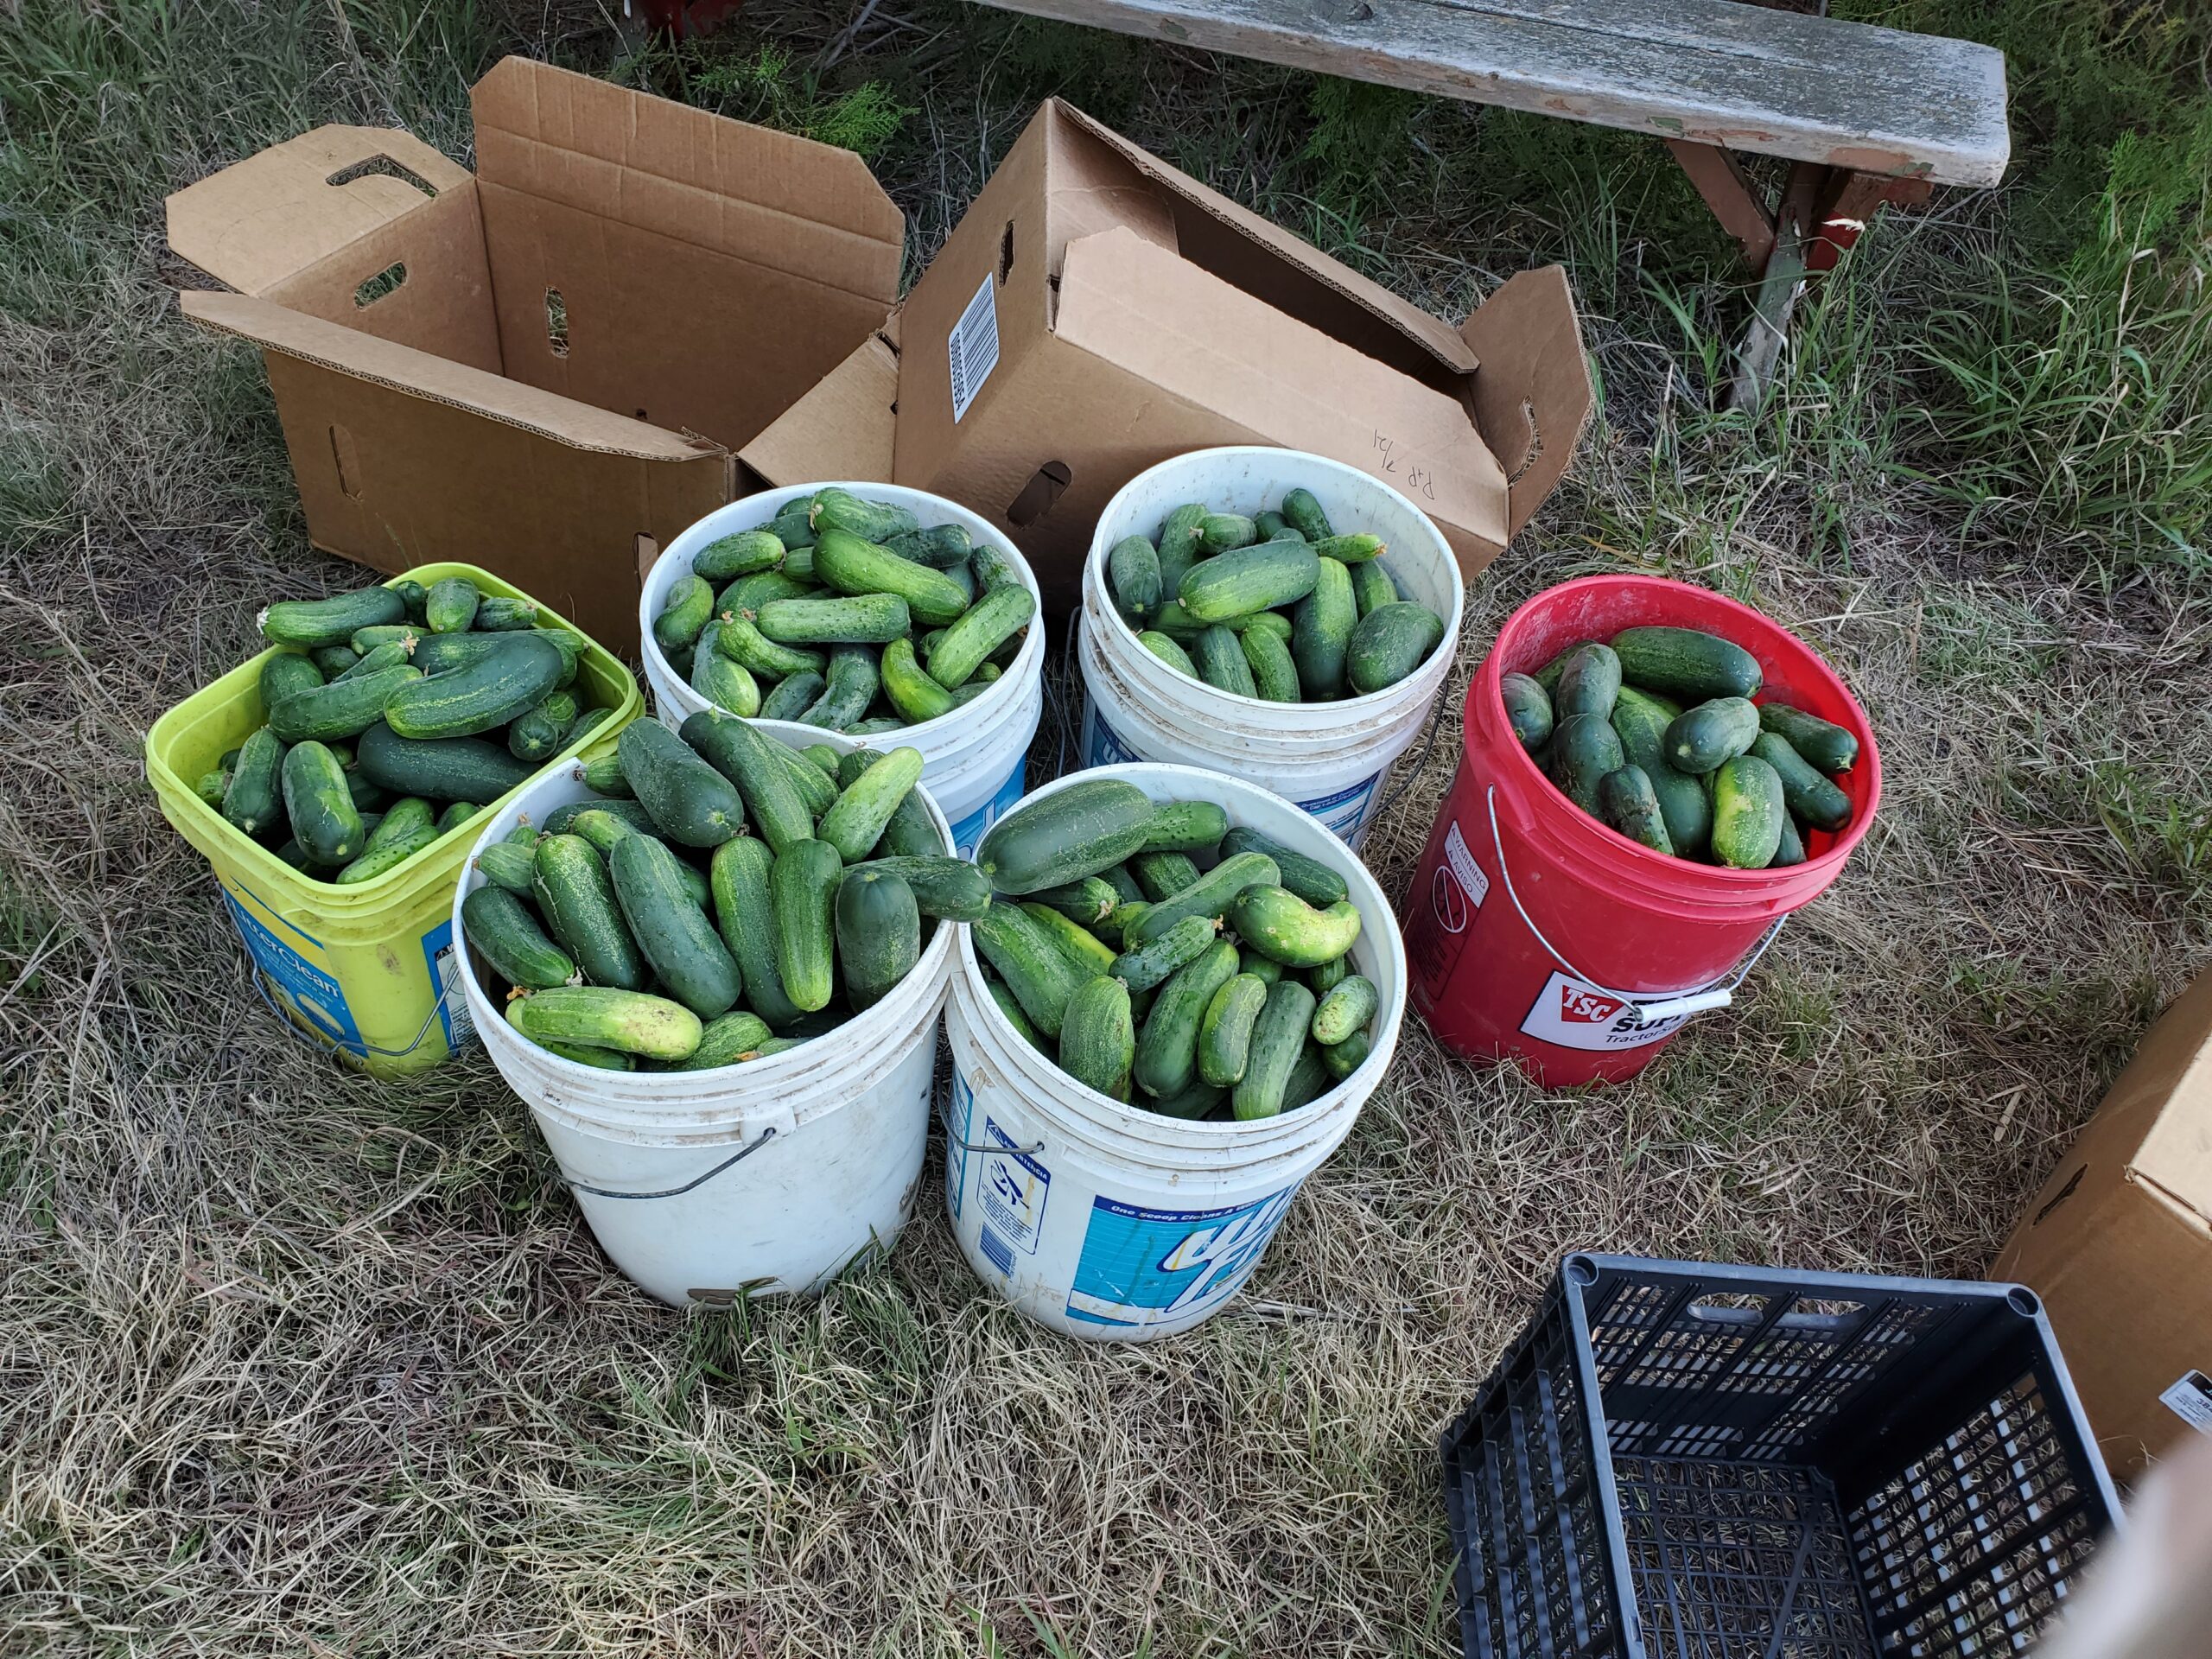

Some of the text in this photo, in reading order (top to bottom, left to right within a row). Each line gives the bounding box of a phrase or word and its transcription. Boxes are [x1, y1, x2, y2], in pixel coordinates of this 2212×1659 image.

[1453, 861, 1473, 893] AVISO
[1455, 836, 1486, 890] WARNING
[1562, 988, 1612, 1022] TSC
[1004, 1140, 1048, 1180] ADRTENCIA
[1110, 1205, 1136, 1216] One
[1138, 1211, 1178, 1222] Scoop
[1180, 1211, 1223, 1221] Cleans
